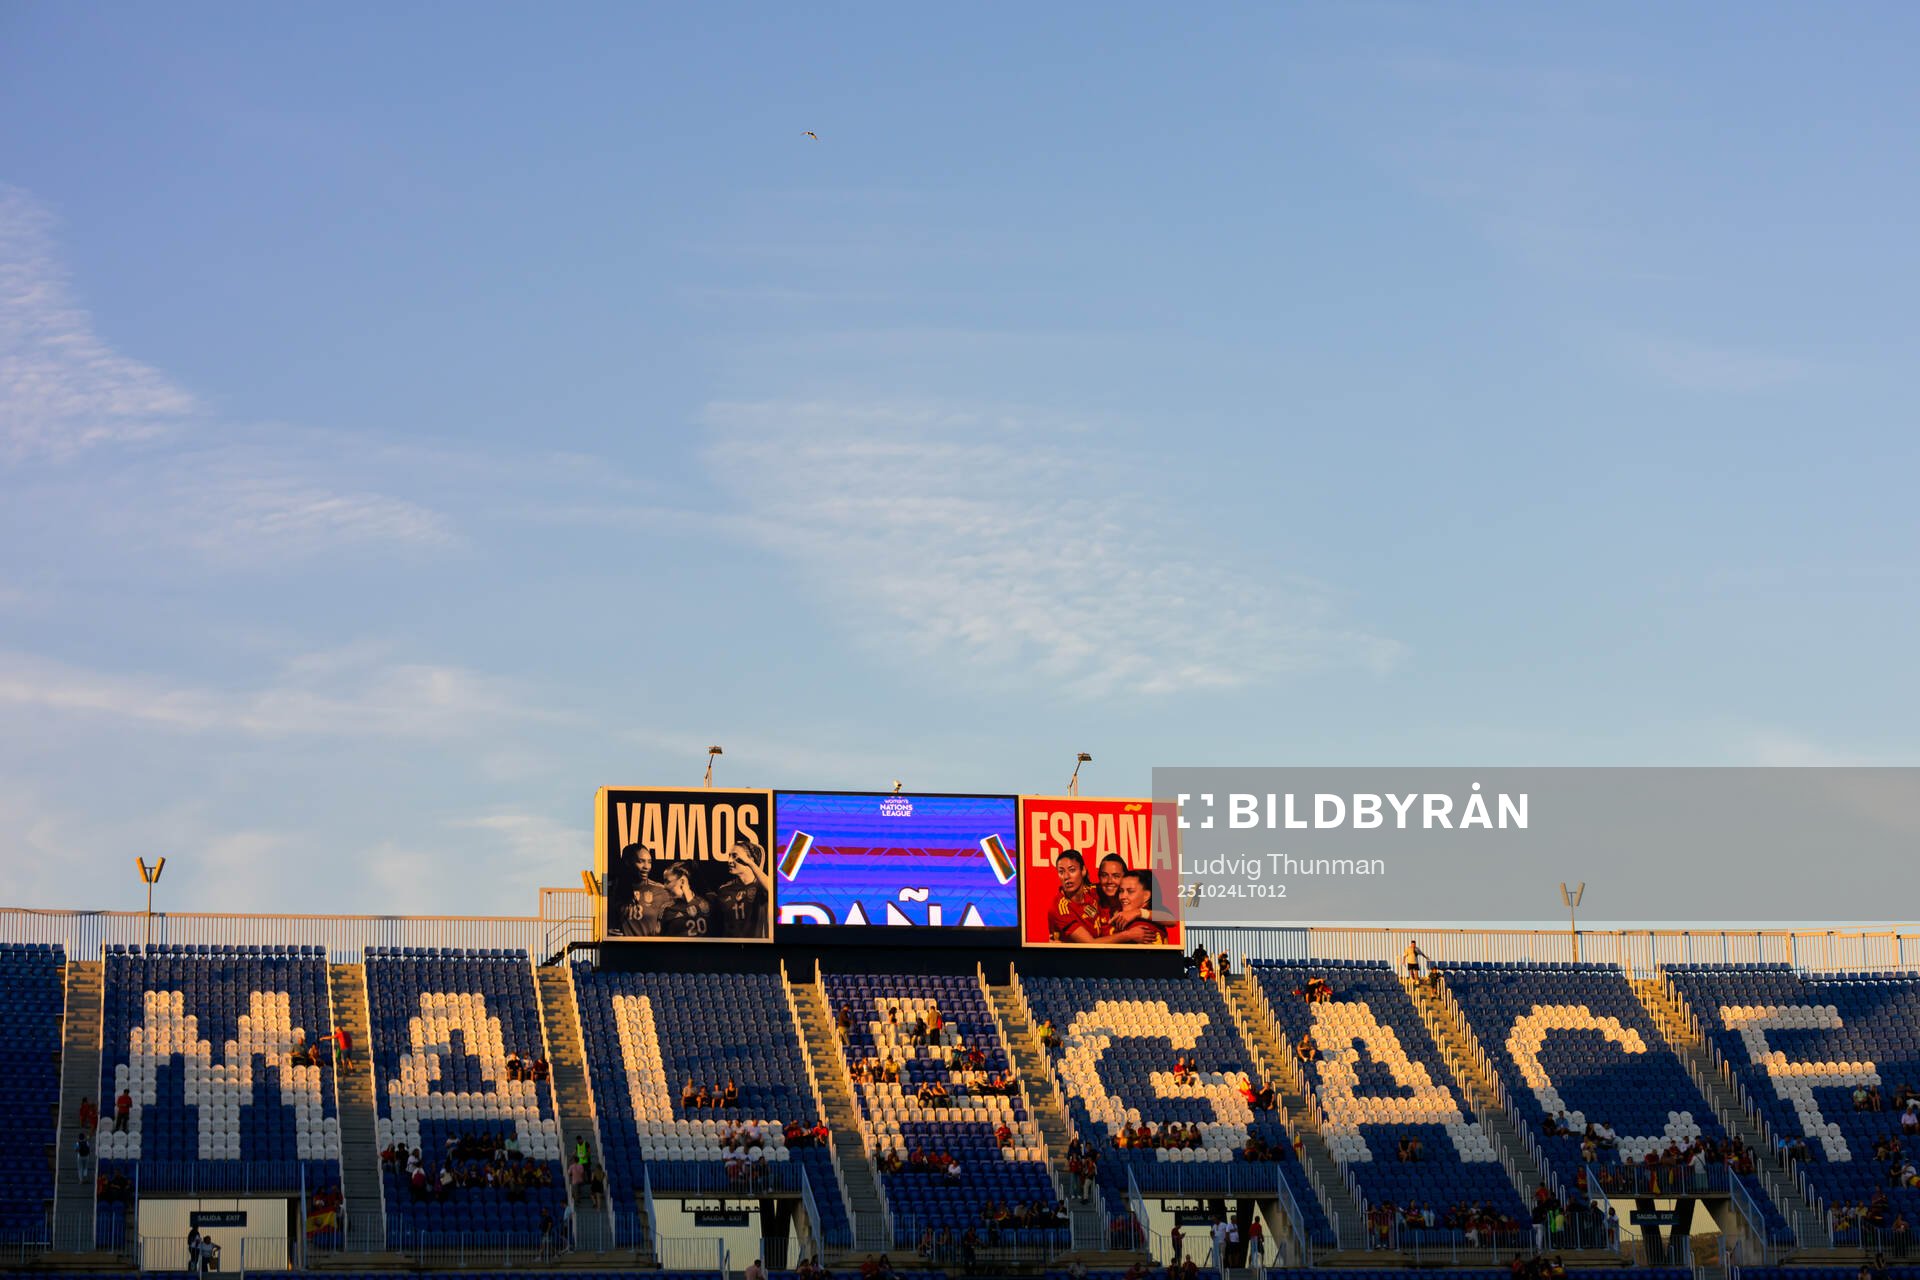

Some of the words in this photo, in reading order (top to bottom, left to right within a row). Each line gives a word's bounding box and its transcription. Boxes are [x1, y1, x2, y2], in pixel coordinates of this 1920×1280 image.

[616, 802, 760, 862] VAMOS
[1031, 803, 1173, 870] ESPAÑA
[686, 917, 707, 936] 20
